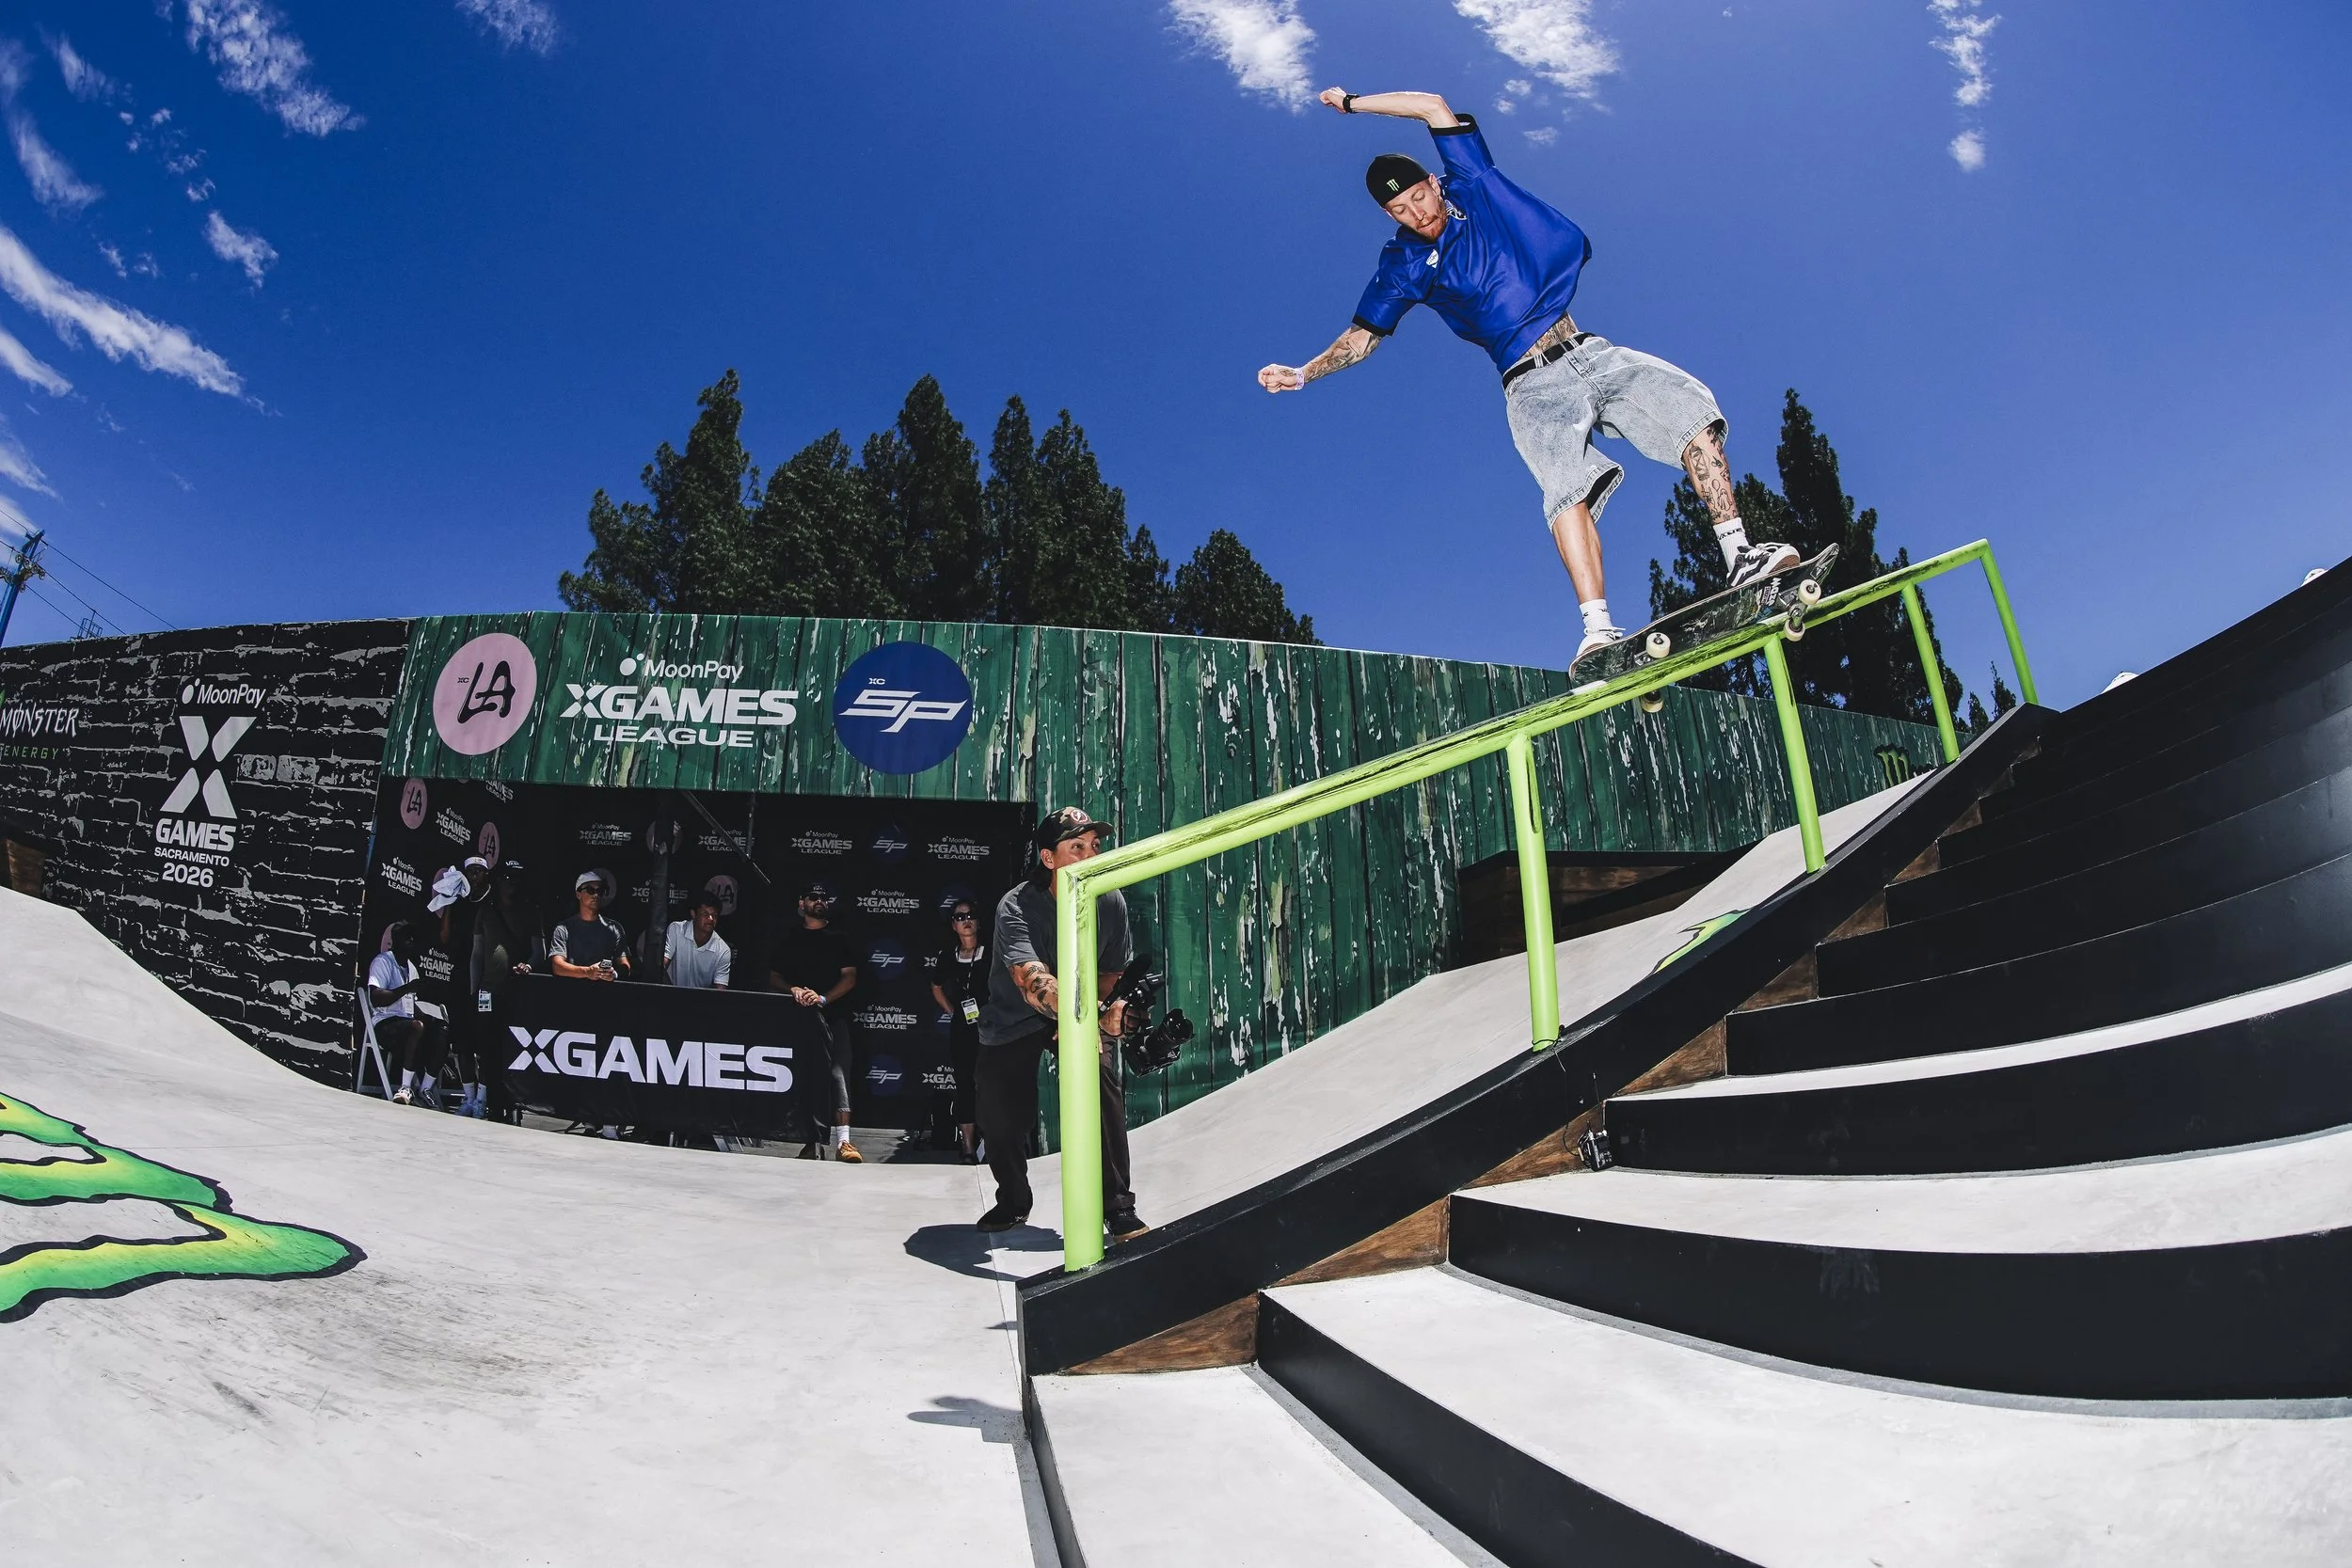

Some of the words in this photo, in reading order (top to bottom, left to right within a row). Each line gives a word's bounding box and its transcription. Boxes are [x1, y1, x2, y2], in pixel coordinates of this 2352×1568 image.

[644, 659, 744, 683] MoonPay
[197, 683, 266, 708] MoonPay
[457, 660, 516, 723] LA
[560, 684, 799, 726] XGAMES
[594, 724, 755, 748] LEAGUE
[4, 745, 58, 760] ENERGY
[155, 818, 236, 852] GAMES
[440, 828, 464, 846] LEAGUE
[791, 838, 852, 849] XGAMES
[154, 847, 230, 867] SACRAMENTO
[927, 844, 990, 855] XGAMES
[162, 863, 214, 888] 2026
[381, 863, 422, 891] XGAMES
[389, 880, 415, 896] LEAGUE
[857, 896, 919, 909] XGAMES
[419, 955, 454, 974] XGAME
[425, 971, 451, 981] LEAGUE
[852, 1012, 917, 1024] XGAMES
[507, 1025, 793, 1093] XGAMES
